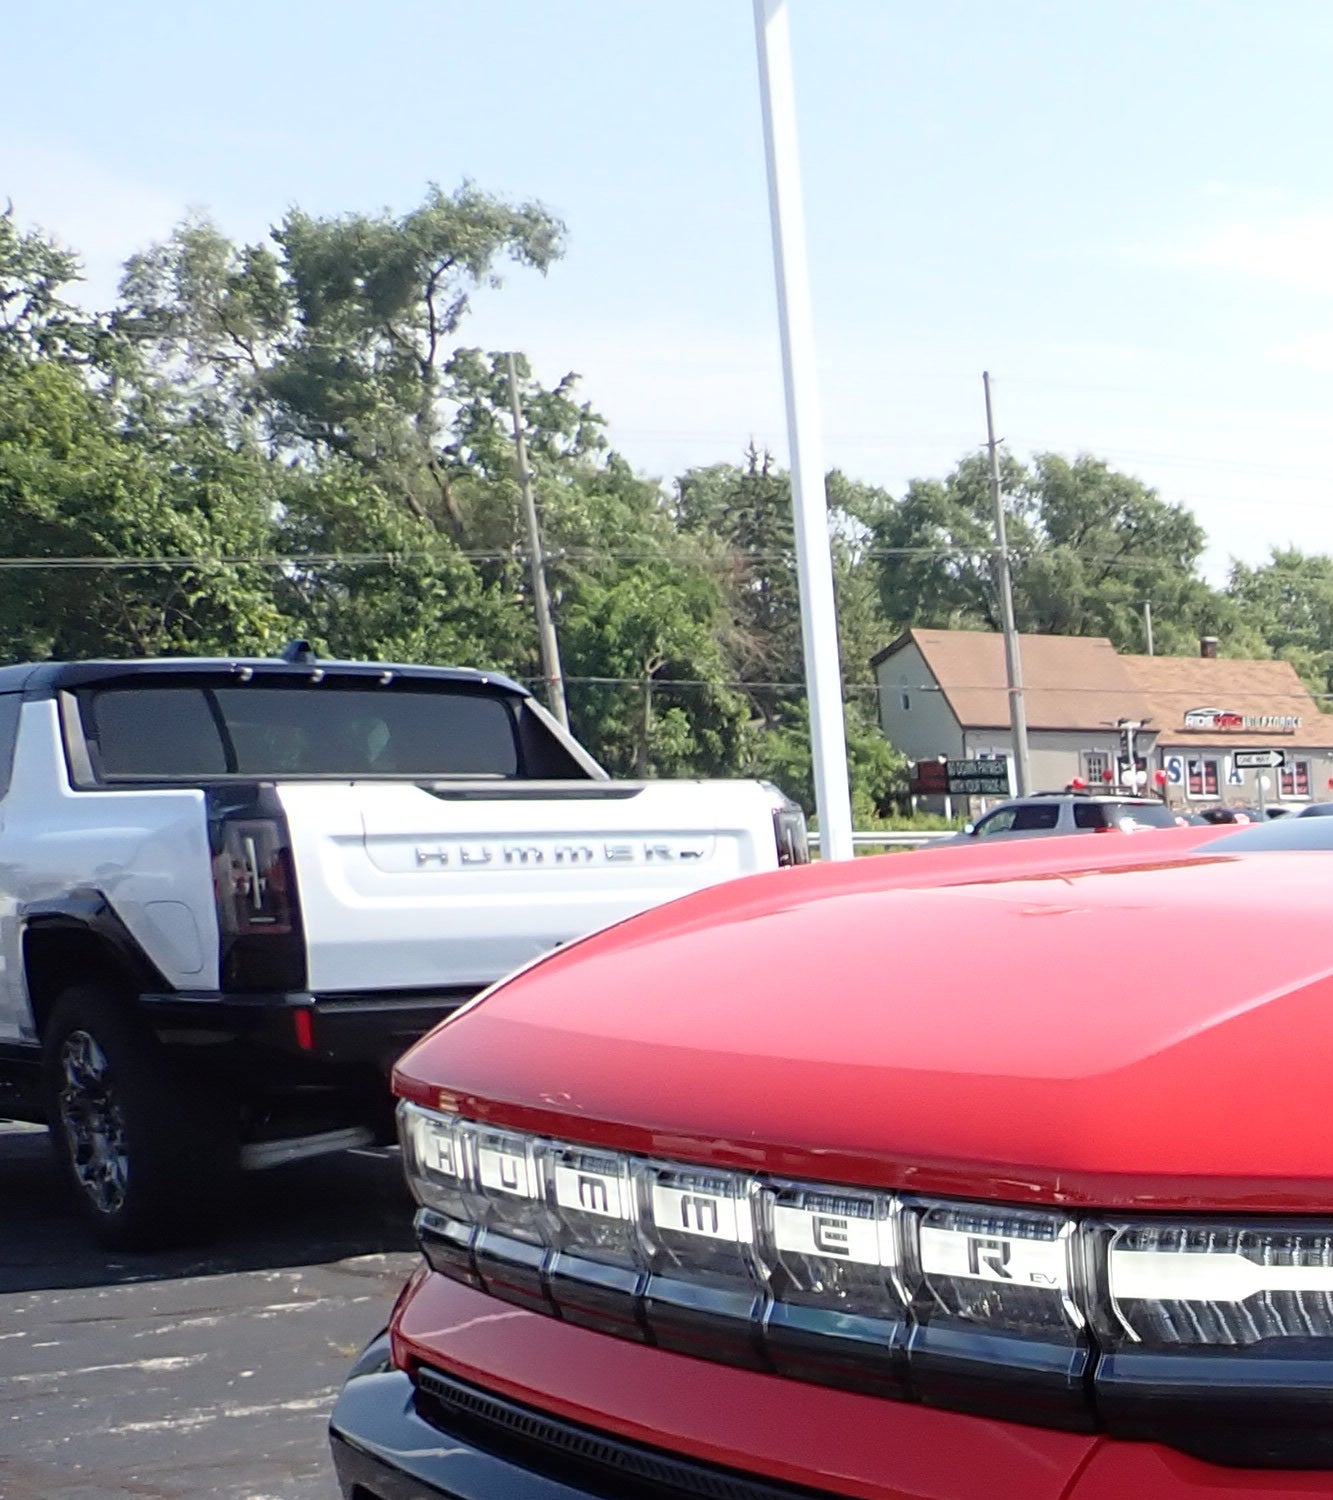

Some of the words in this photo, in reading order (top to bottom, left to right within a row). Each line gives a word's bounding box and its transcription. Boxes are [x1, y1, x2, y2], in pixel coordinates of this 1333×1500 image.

[1238, 755, 1253, 764] ONE
[1255, 755, 1271, 763] WAY
[414, 841, 675, 867] HUMMER
[432, 1132, 1014, 1284] HUMMER
